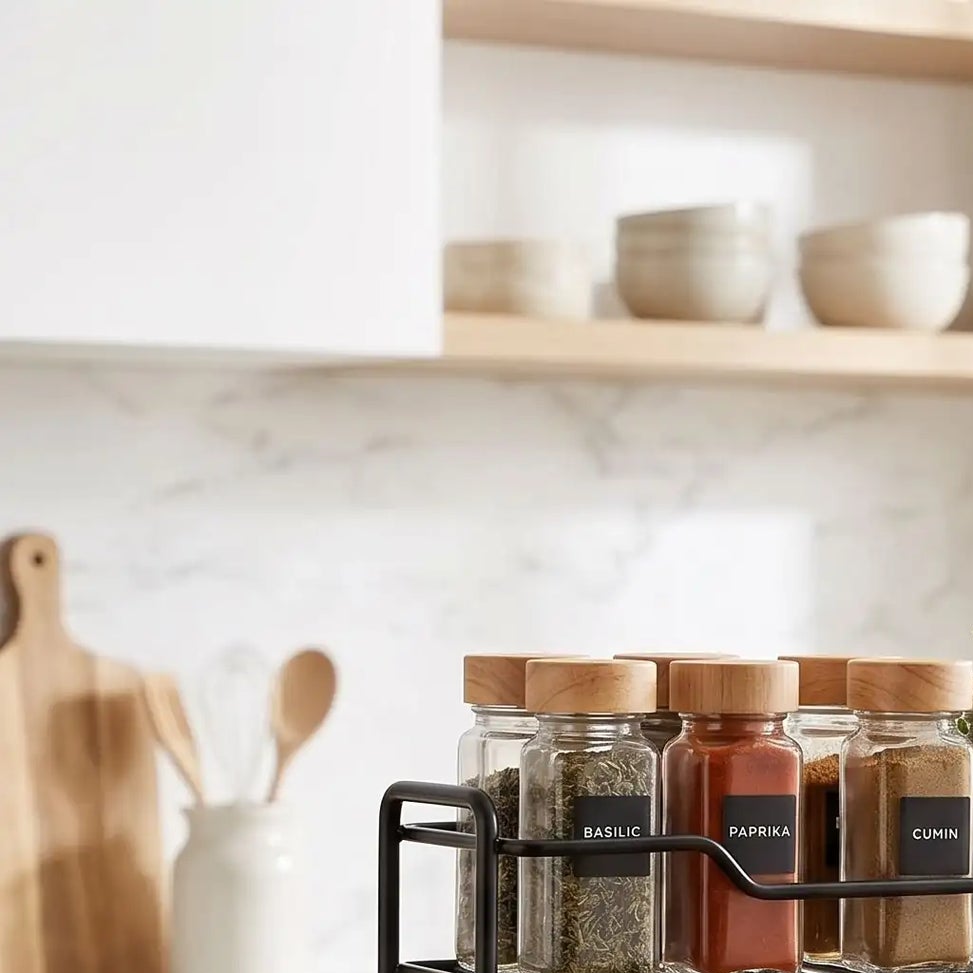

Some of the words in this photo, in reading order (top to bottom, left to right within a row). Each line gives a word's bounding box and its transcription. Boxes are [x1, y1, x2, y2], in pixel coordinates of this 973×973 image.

[583, 826, 641, 838] BASILIC
[729, 826, 791, 838] PAPRIKA
[912, 828, 958, 840] CUMIN
